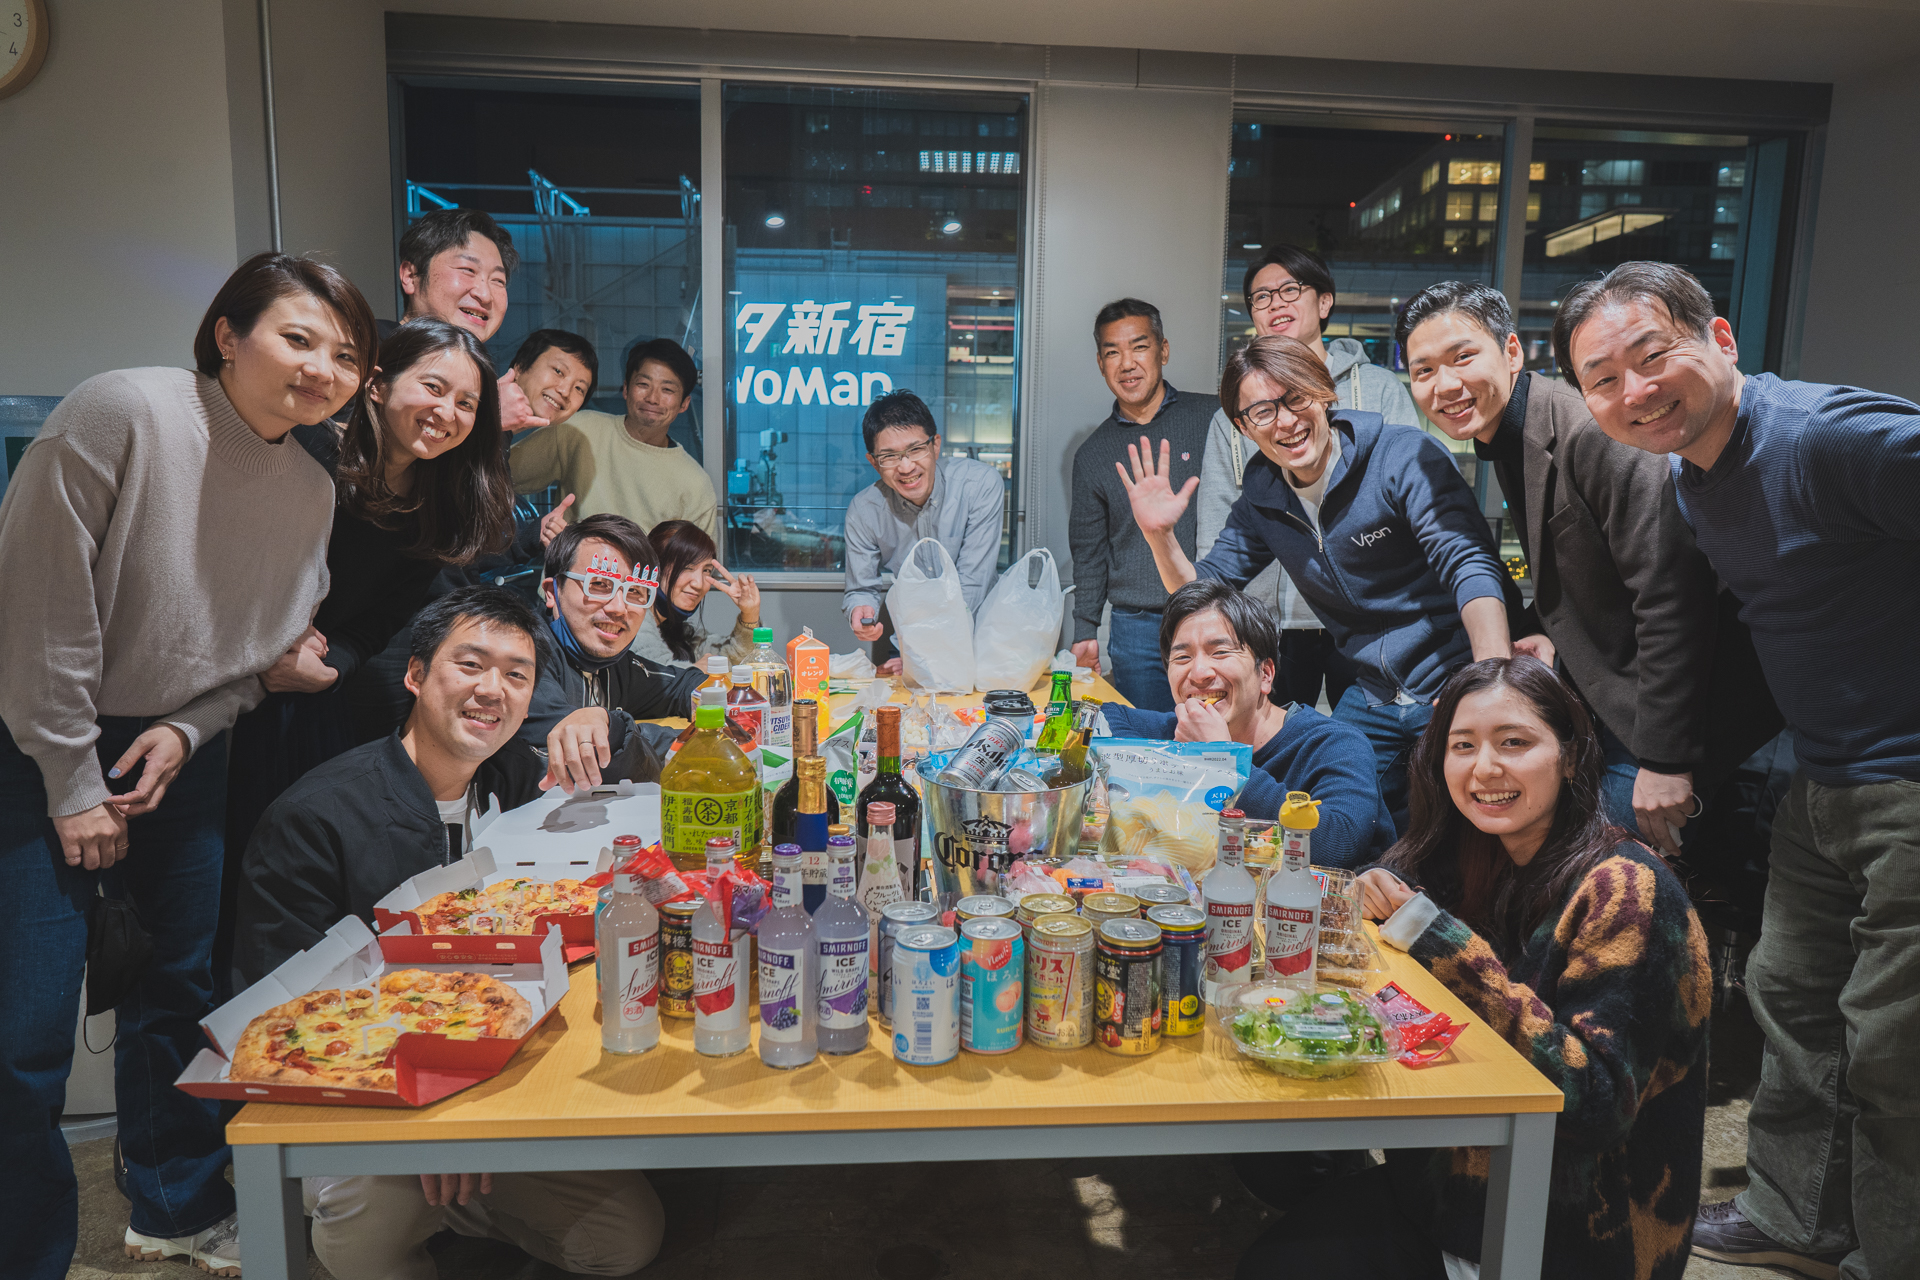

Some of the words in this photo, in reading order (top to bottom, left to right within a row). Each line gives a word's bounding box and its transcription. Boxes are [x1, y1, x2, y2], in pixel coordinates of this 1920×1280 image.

[13, 12, 22, 27] 3
[9, 41, 18, 56] 4
[1350, 526, 1392, 547] Vpon
[801, 669, 824, 677] オレンジ
[966, 738, 1009, 770] Asahi
[974, 756, 987, 768] 生
[699, 802, 718, 822] 茶
[724, 799, 738, 825] 京都
[662, 794, 676, 850] 伊右衛門
[744, 794, 754, 849] 伊右衛門
[933, 831, 1042, 874] Coro
[809, 856, 820, 865] 12
[1211, 905, 1252, 915] SMIRNOFF
[1268, 907, 1310, 921] SMIRNOFF
[1222, 920, 1242, 928] ICE
[1278, 922, 1297, 933] ICE
[822, 941, 867, 954] SMIRNOFF
[1034, 936, 1058, 948] SUNTORY
[697, 957, 715, 968] ICE
[836, 956, 857, 967] ICE
[1029, 950, 1065, 974] トリス
[760, 965, 775, 978] ICE
[625, 1006, 643, 1016] お酒
[1182, 1001, 1197, 1011] お酒
